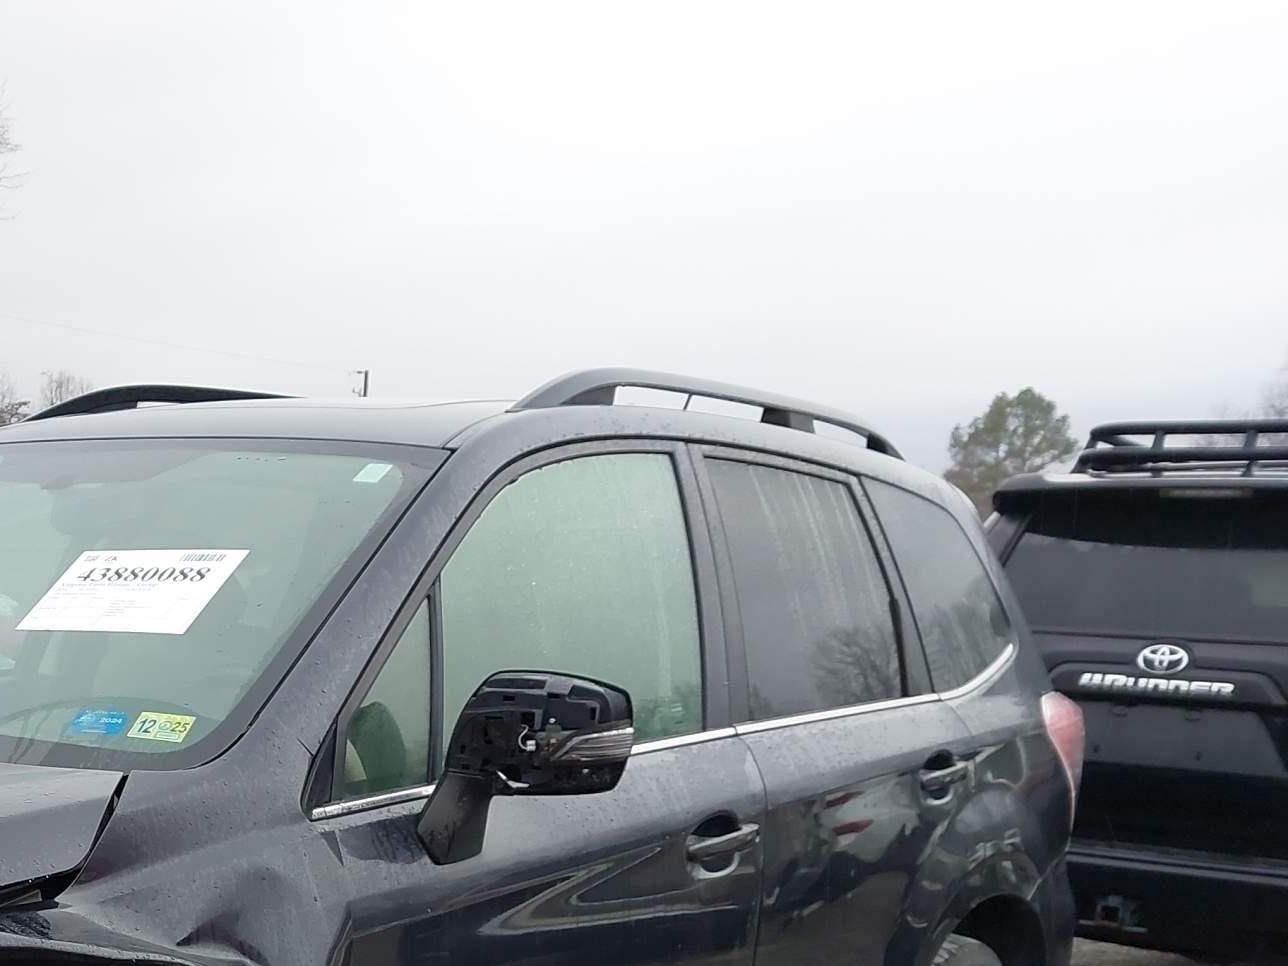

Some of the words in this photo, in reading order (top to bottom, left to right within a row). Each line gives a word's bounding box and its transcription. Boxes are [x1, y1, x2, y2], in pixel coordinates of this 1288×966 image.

[77, 566, 211, 582] 43880088
[137, 718, 157, 734] 12
[169, 722, 189, 733] 25
